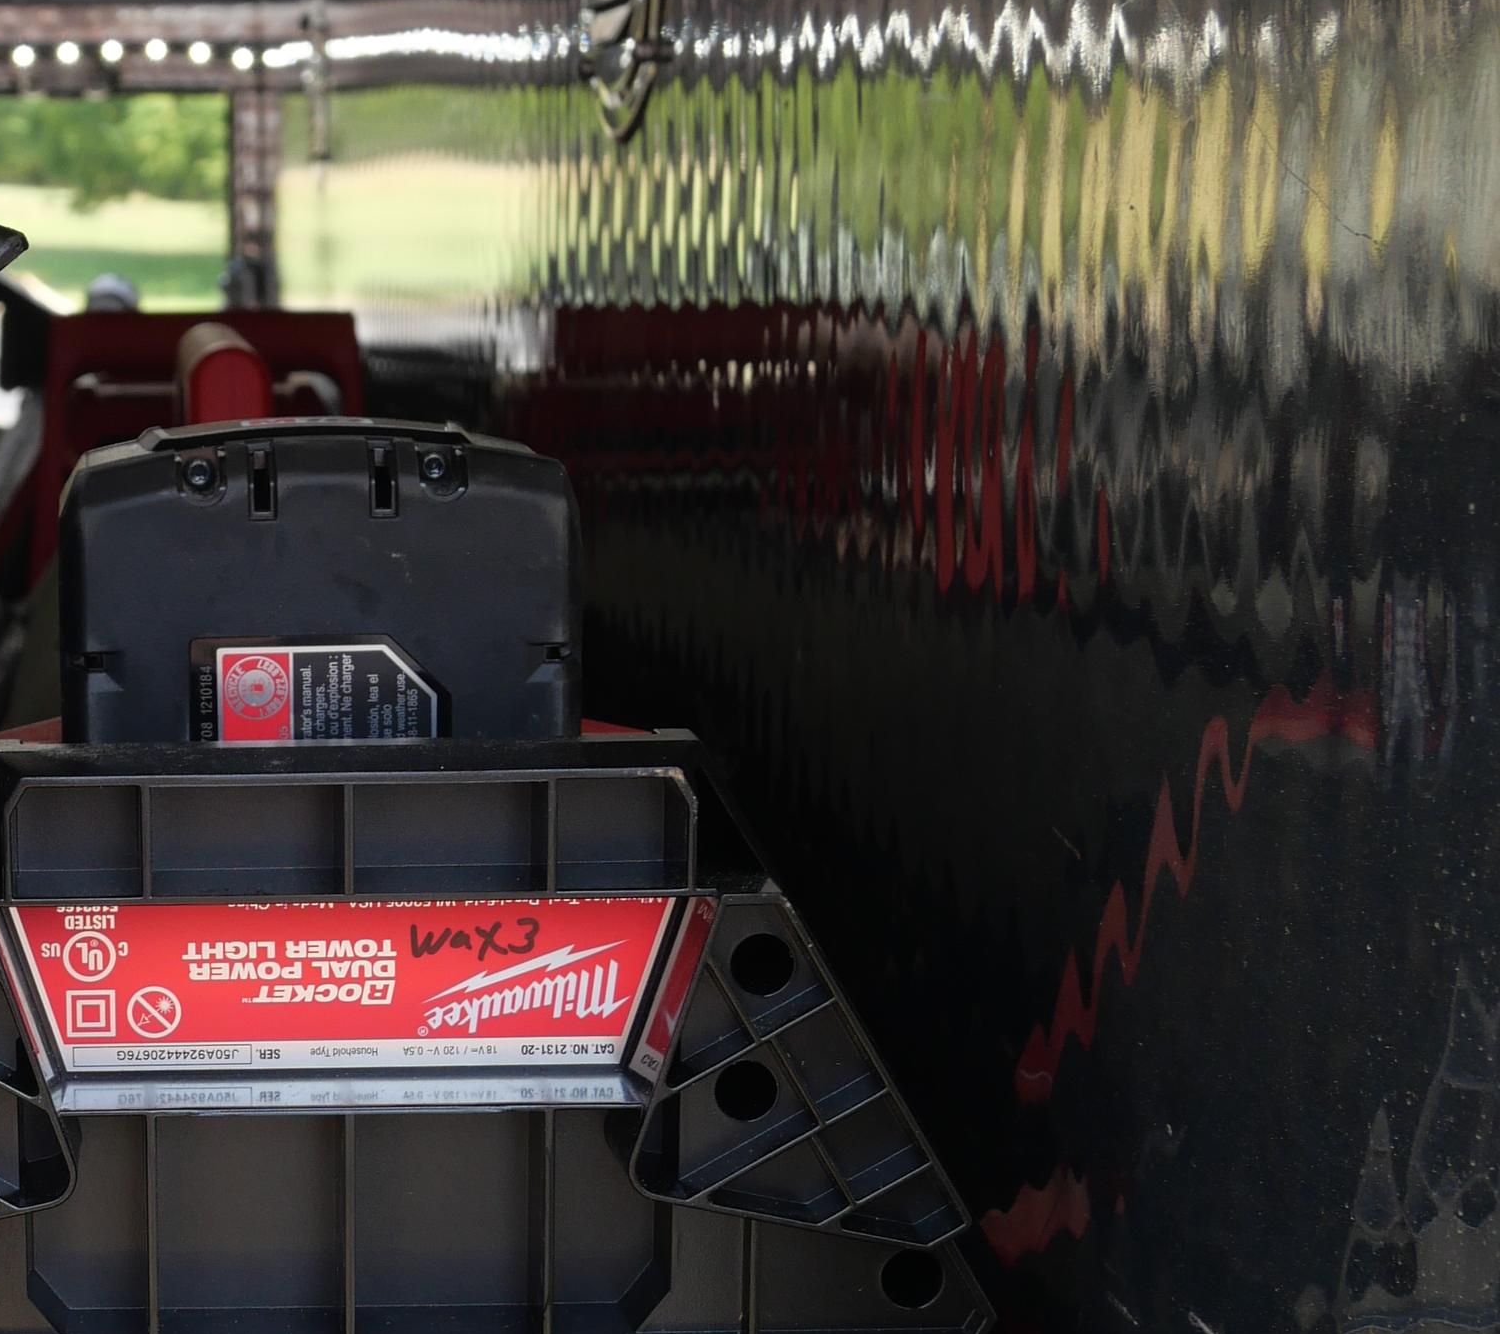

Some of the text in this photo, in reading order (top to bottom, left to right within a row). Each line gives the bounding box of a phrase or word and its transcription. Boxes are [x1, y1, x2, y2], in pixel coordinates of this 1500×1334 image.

[340, 653, 355, 694] charger
[366, 673, 379, 684] el
[200, 665, 213, 715] 1210184
[299, 664, 312, 706] manual.
[366, 686, 379, 702] lea
[314, 683, 328, 731] chargers.
[341, 695, 352, 711] Ne
[395, 693, 406, 731] weather
[64, 914, 115, 930] LISTED
[181, 939, 397, 960] TOWER LIGHT
[188, 959, 396, 981] DUAL POWER
[255, 1048, 281, 1060] SER.
[309, 1046, 331, 1058] Type
[332, 1047, 379, 1057] Household
[402, 1046, 424, 1056] 0.5A
[443, 1045, 460, 1055] 120
[486, 1045, 497, 1055] 18
[520, 1044, 567, 1055] 2131-20
[591, 1043, 615, 1055] CAT.
